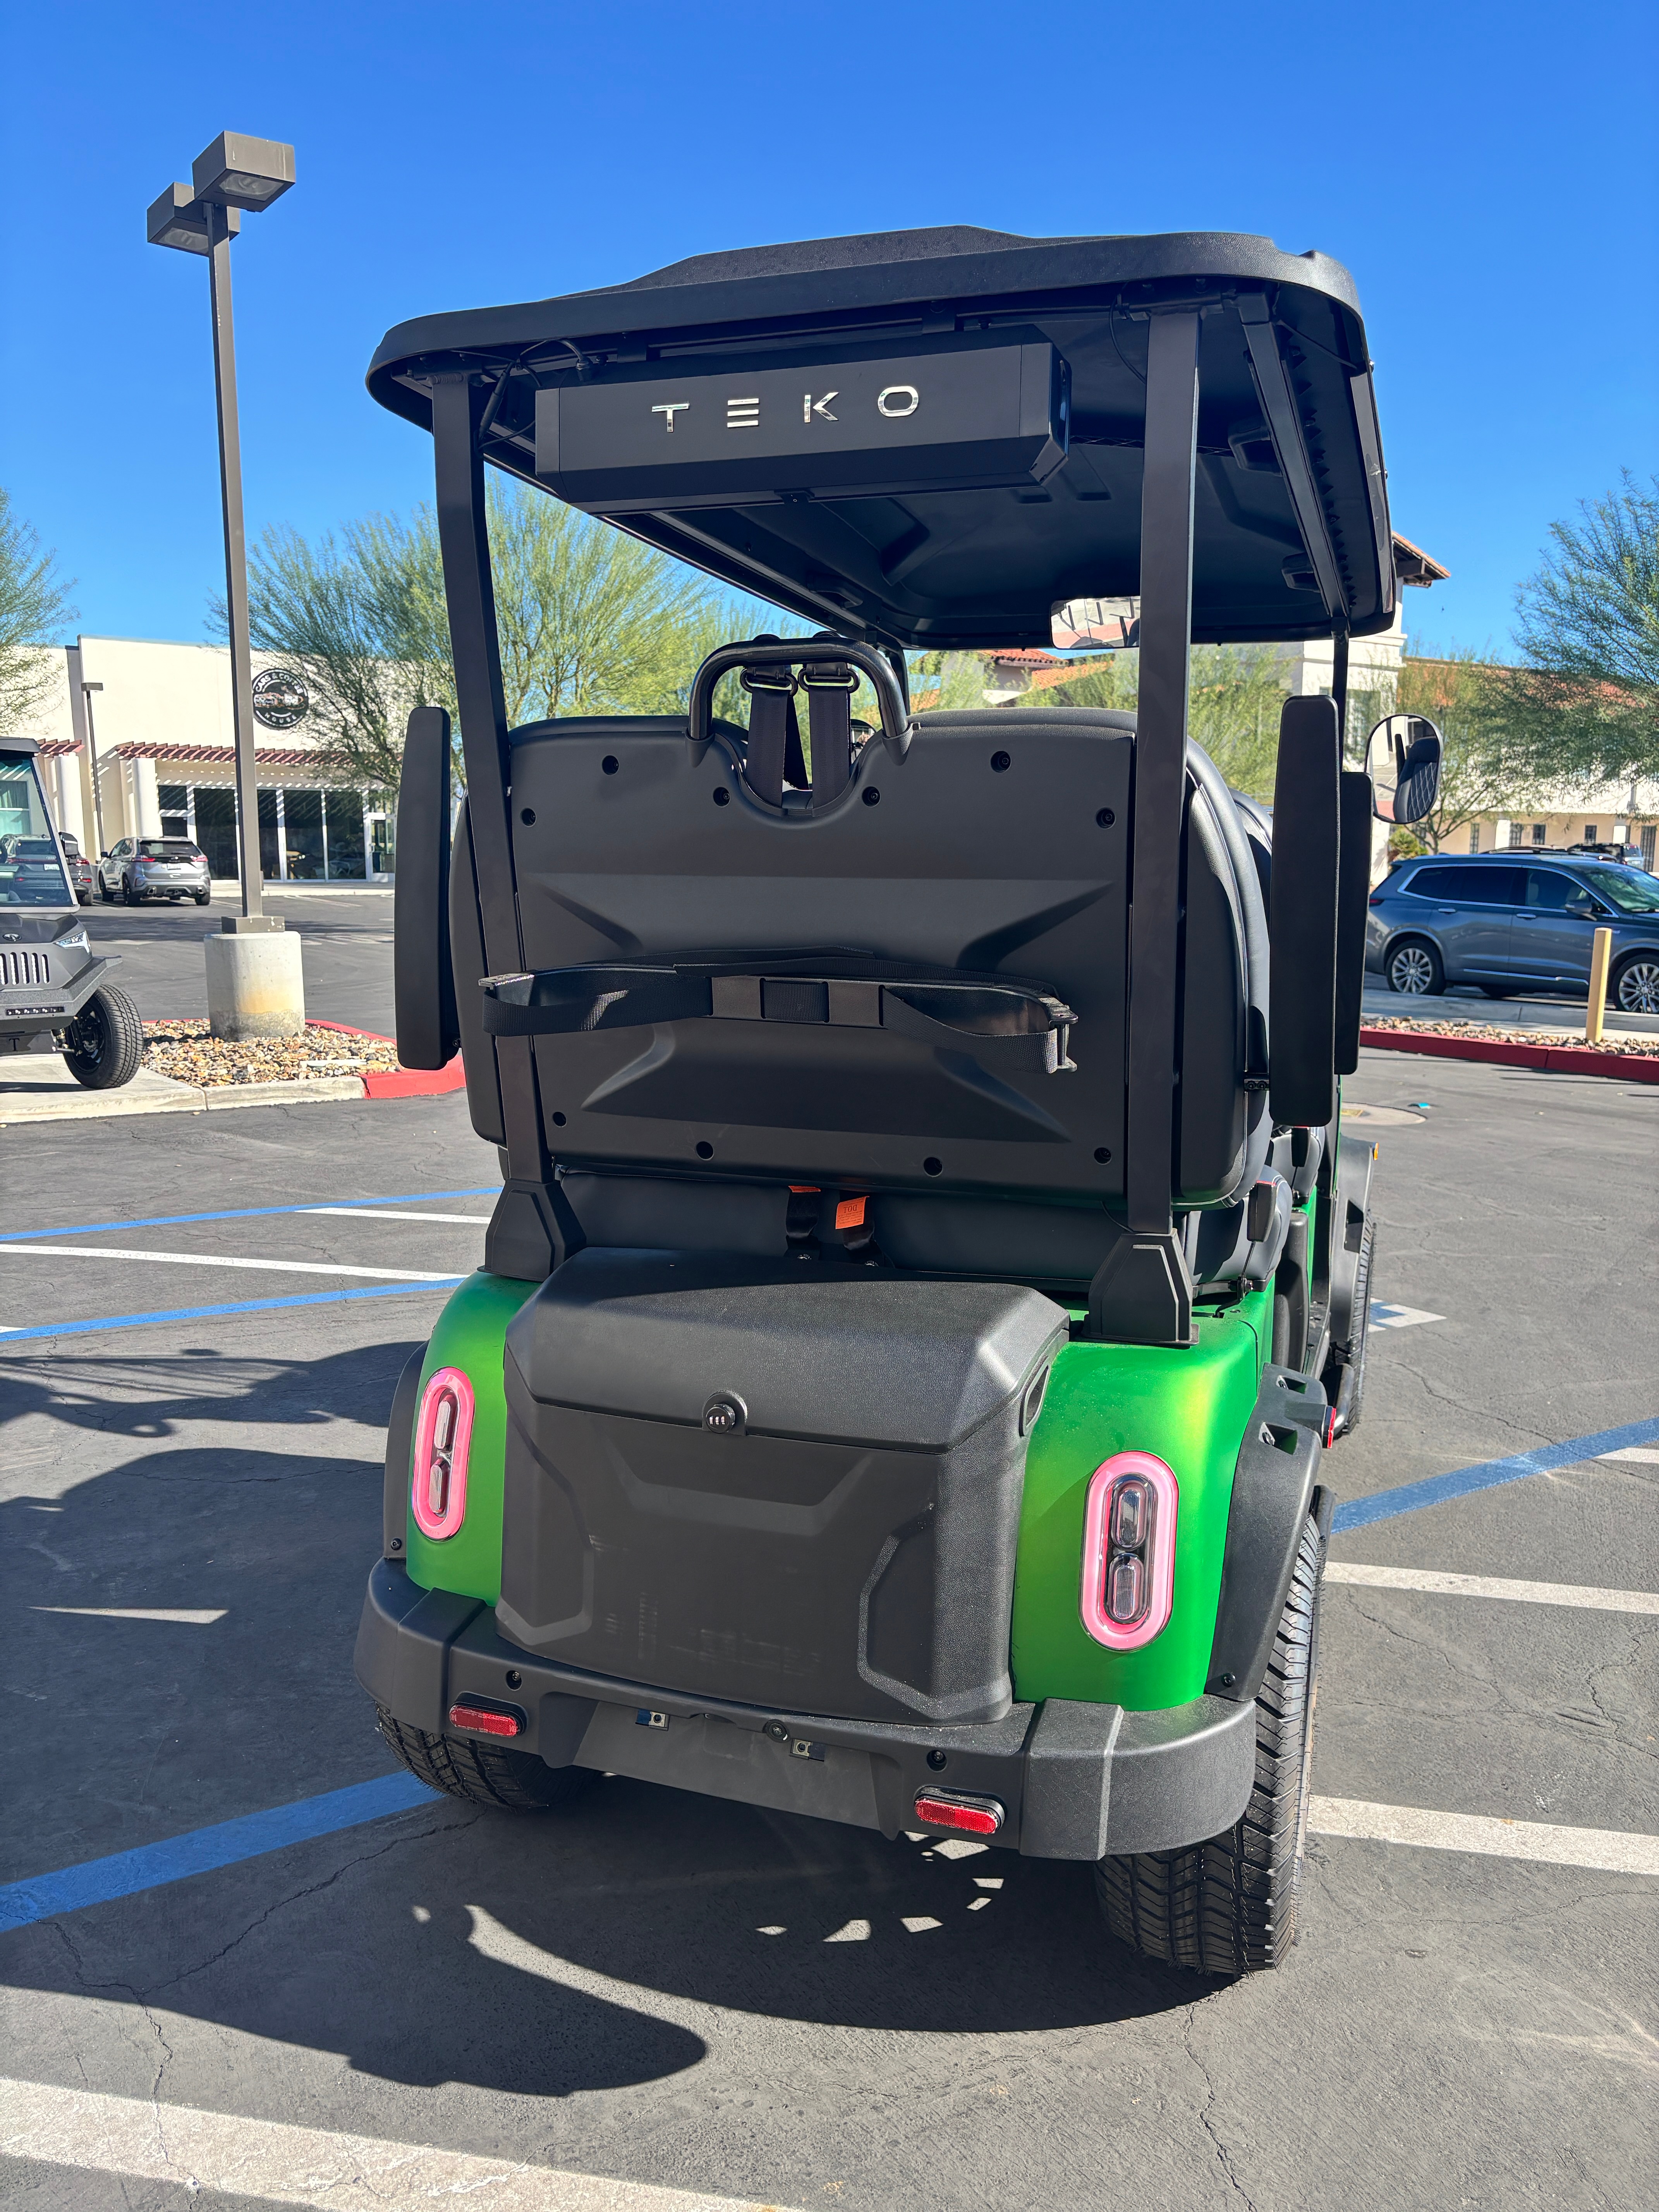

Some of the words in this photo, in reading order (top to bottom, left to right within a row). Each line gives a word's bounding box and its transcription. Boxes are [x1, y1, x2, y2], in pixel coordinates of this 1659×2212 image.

[652, 385, 919, 433] TEKO
[256, 675, 271, 692] CARS
[264, 712, 297, 723] HOUSE
